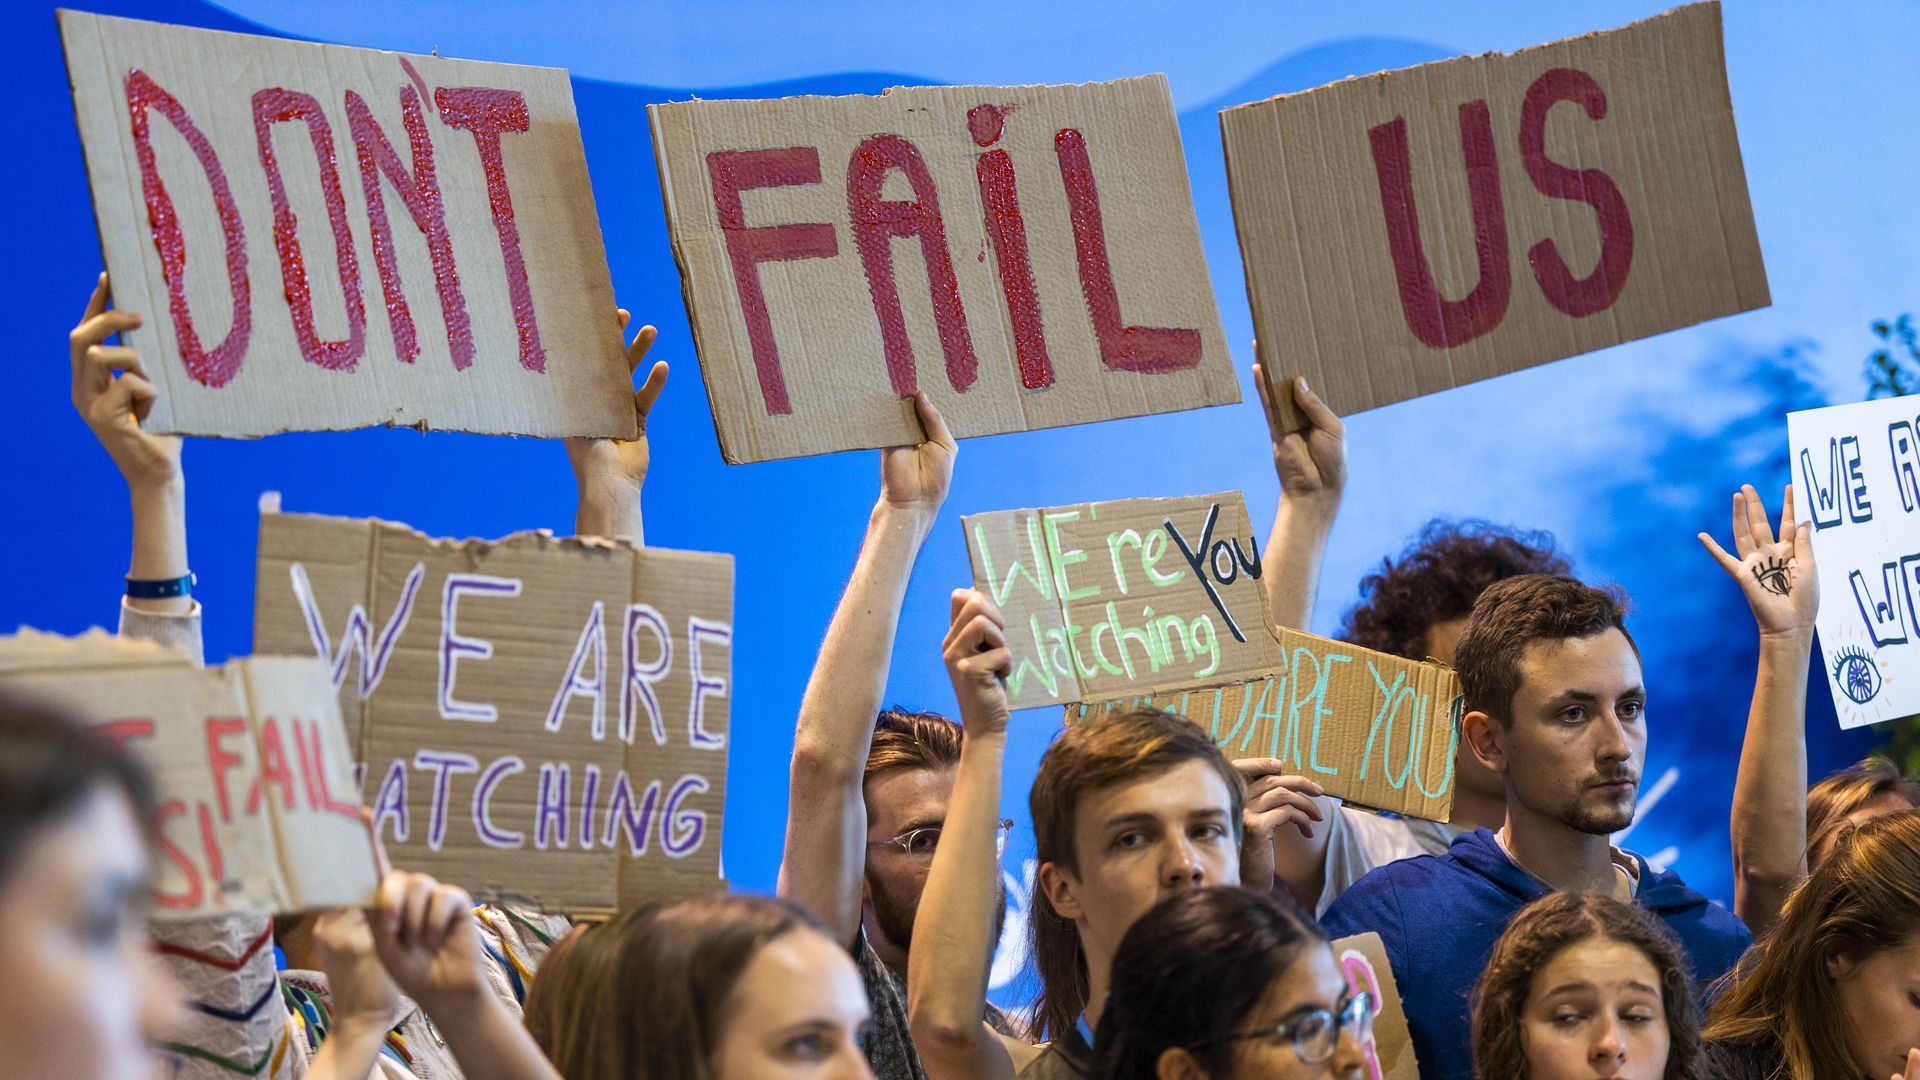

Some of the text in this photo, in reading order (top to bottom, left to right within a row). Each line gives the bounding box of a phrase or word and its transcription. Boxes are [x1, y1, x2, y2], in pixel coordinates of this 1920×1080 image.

[124, 57, 546, 389] DON'T
[1367, 68, 1633, 349] US
[1801, 420, 1920, 532] WE A
[1163, 503, 1262, 643] You
[290, 562, 732, 751] WE ARE
[206, 717, 360, 823] FAIL
[1360, 660, 1464, 798] YOU
[351, 750, 710, 858] ATCHING
